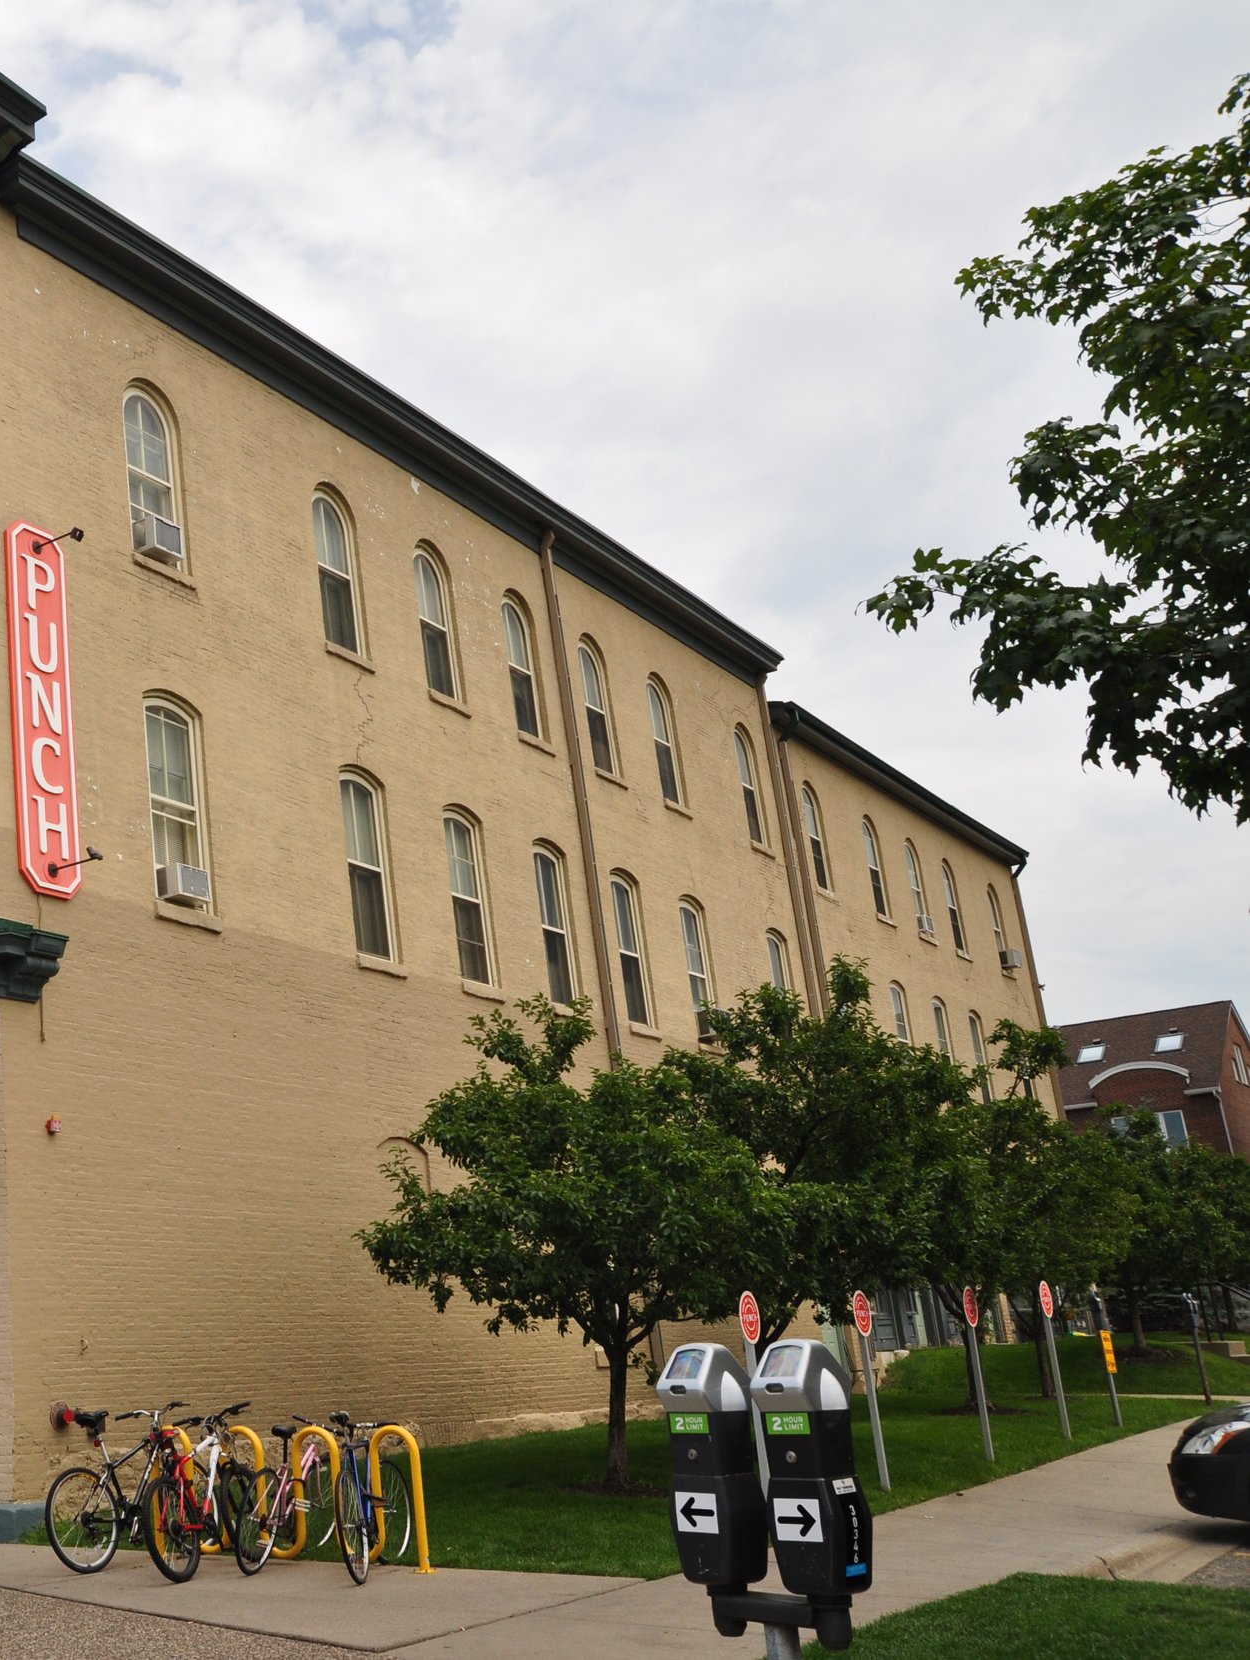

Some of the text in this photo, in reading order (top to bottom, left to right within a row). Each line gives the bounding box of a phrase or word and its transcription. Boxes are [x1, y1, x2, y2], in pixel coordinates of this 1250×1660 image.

[20, 553, 70, 861] PUNCH
[675, 1417, 684, 1430] 2
[772, 1417, 782, 1430] 2
